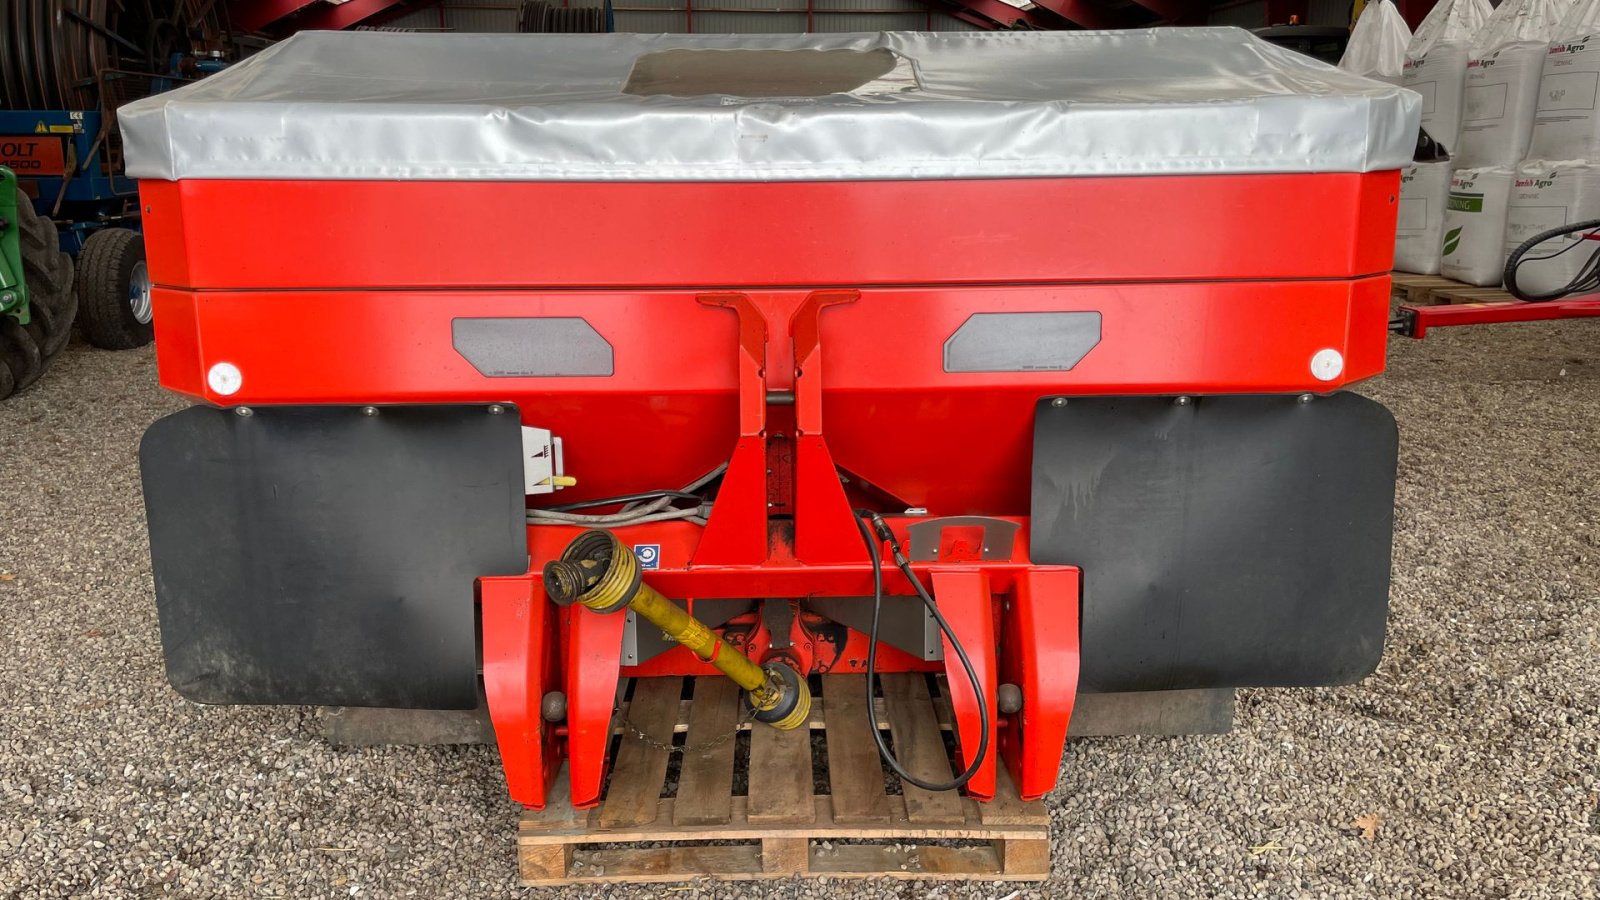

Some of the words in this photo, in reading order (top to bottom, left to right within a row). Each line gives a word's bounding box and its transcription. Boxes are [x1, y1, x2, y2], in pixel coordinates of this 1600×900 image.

[1566, 44, 1585, 53] Agro
[1480, 60, 1495, 68] Agro
[0, 142, 39, 157] OLT
[1460, 179, 1474, 189] Agro
[1534, 179, 1553, 188] Agro
